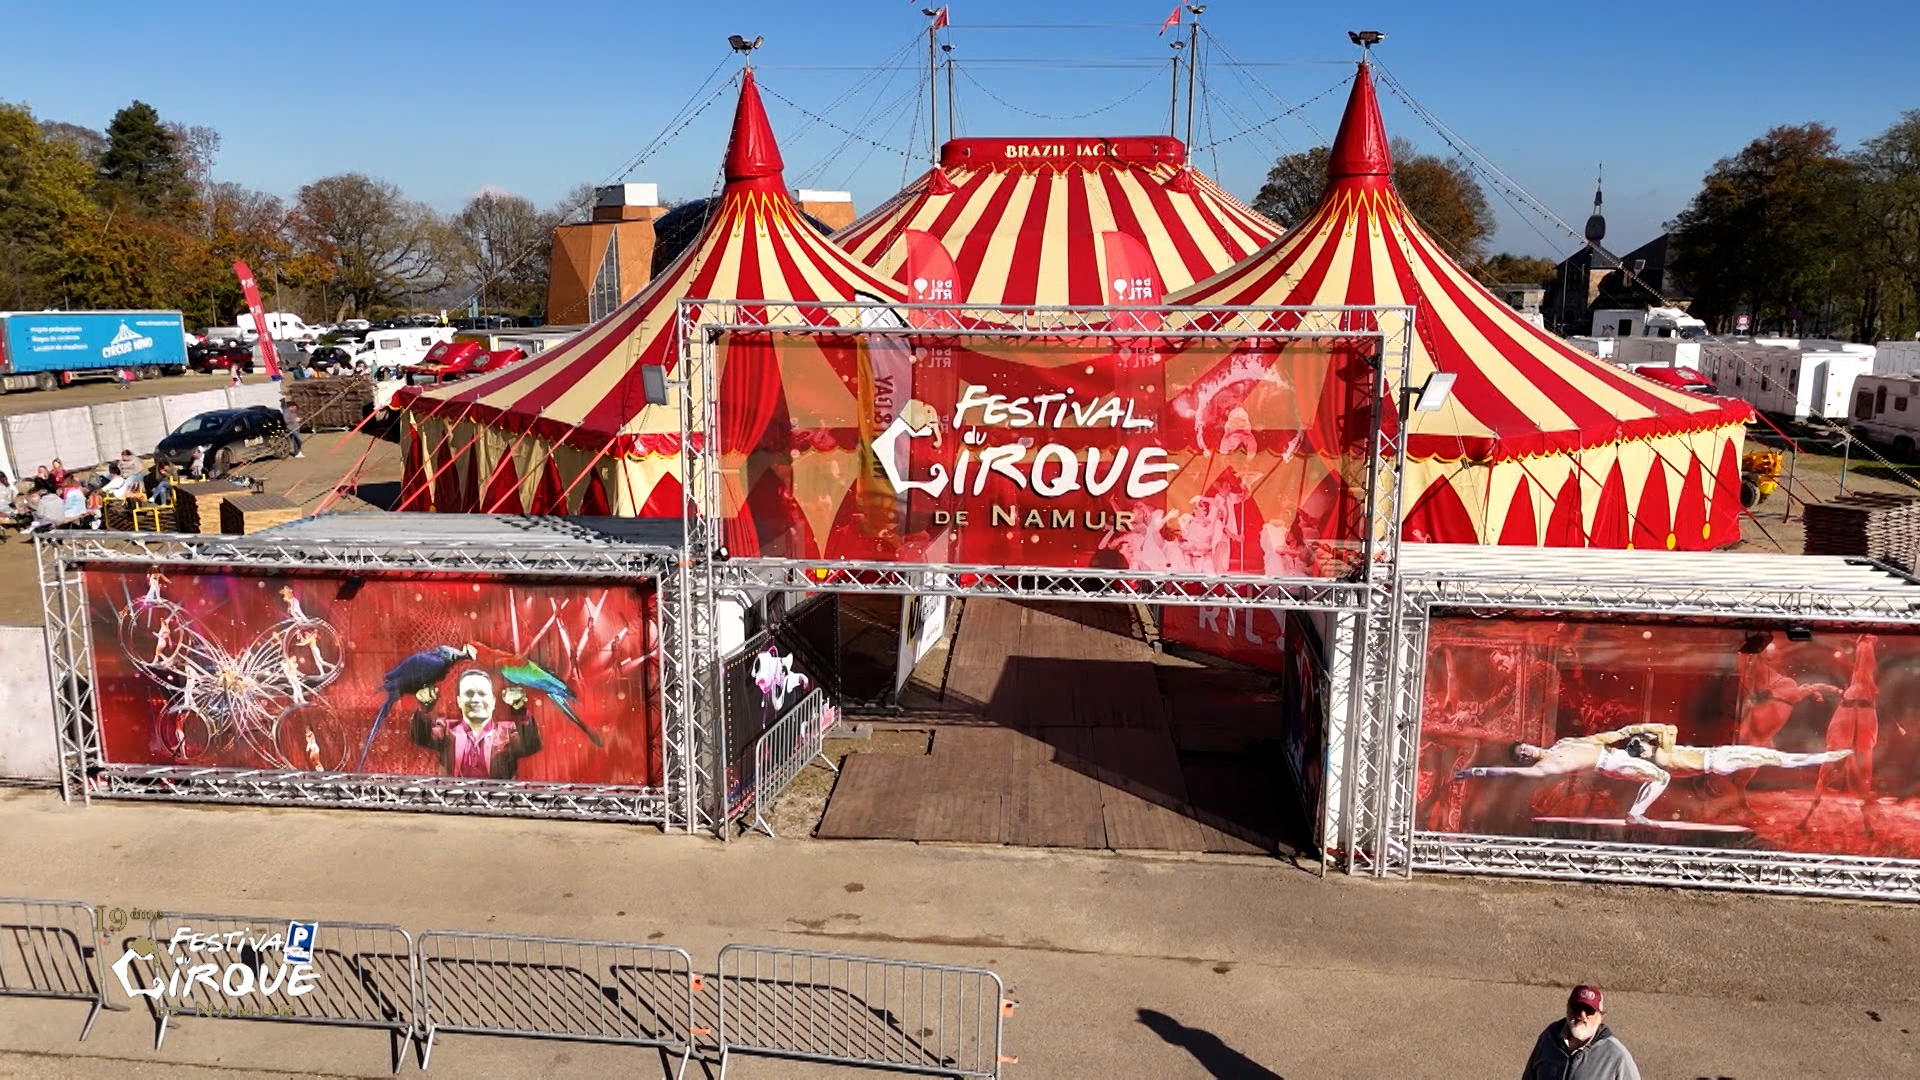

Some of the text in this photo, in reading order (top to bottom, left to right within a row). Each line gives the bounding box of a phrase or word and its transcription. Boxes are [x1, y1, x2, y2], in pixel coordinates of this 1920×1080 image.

[1005, 144, 1119, 158] BRAZIL JACK
[963, 426, 987, 446] du
[934, 504, 1135, 531] DE NAMUR
[293, 927, 309, 946] P
